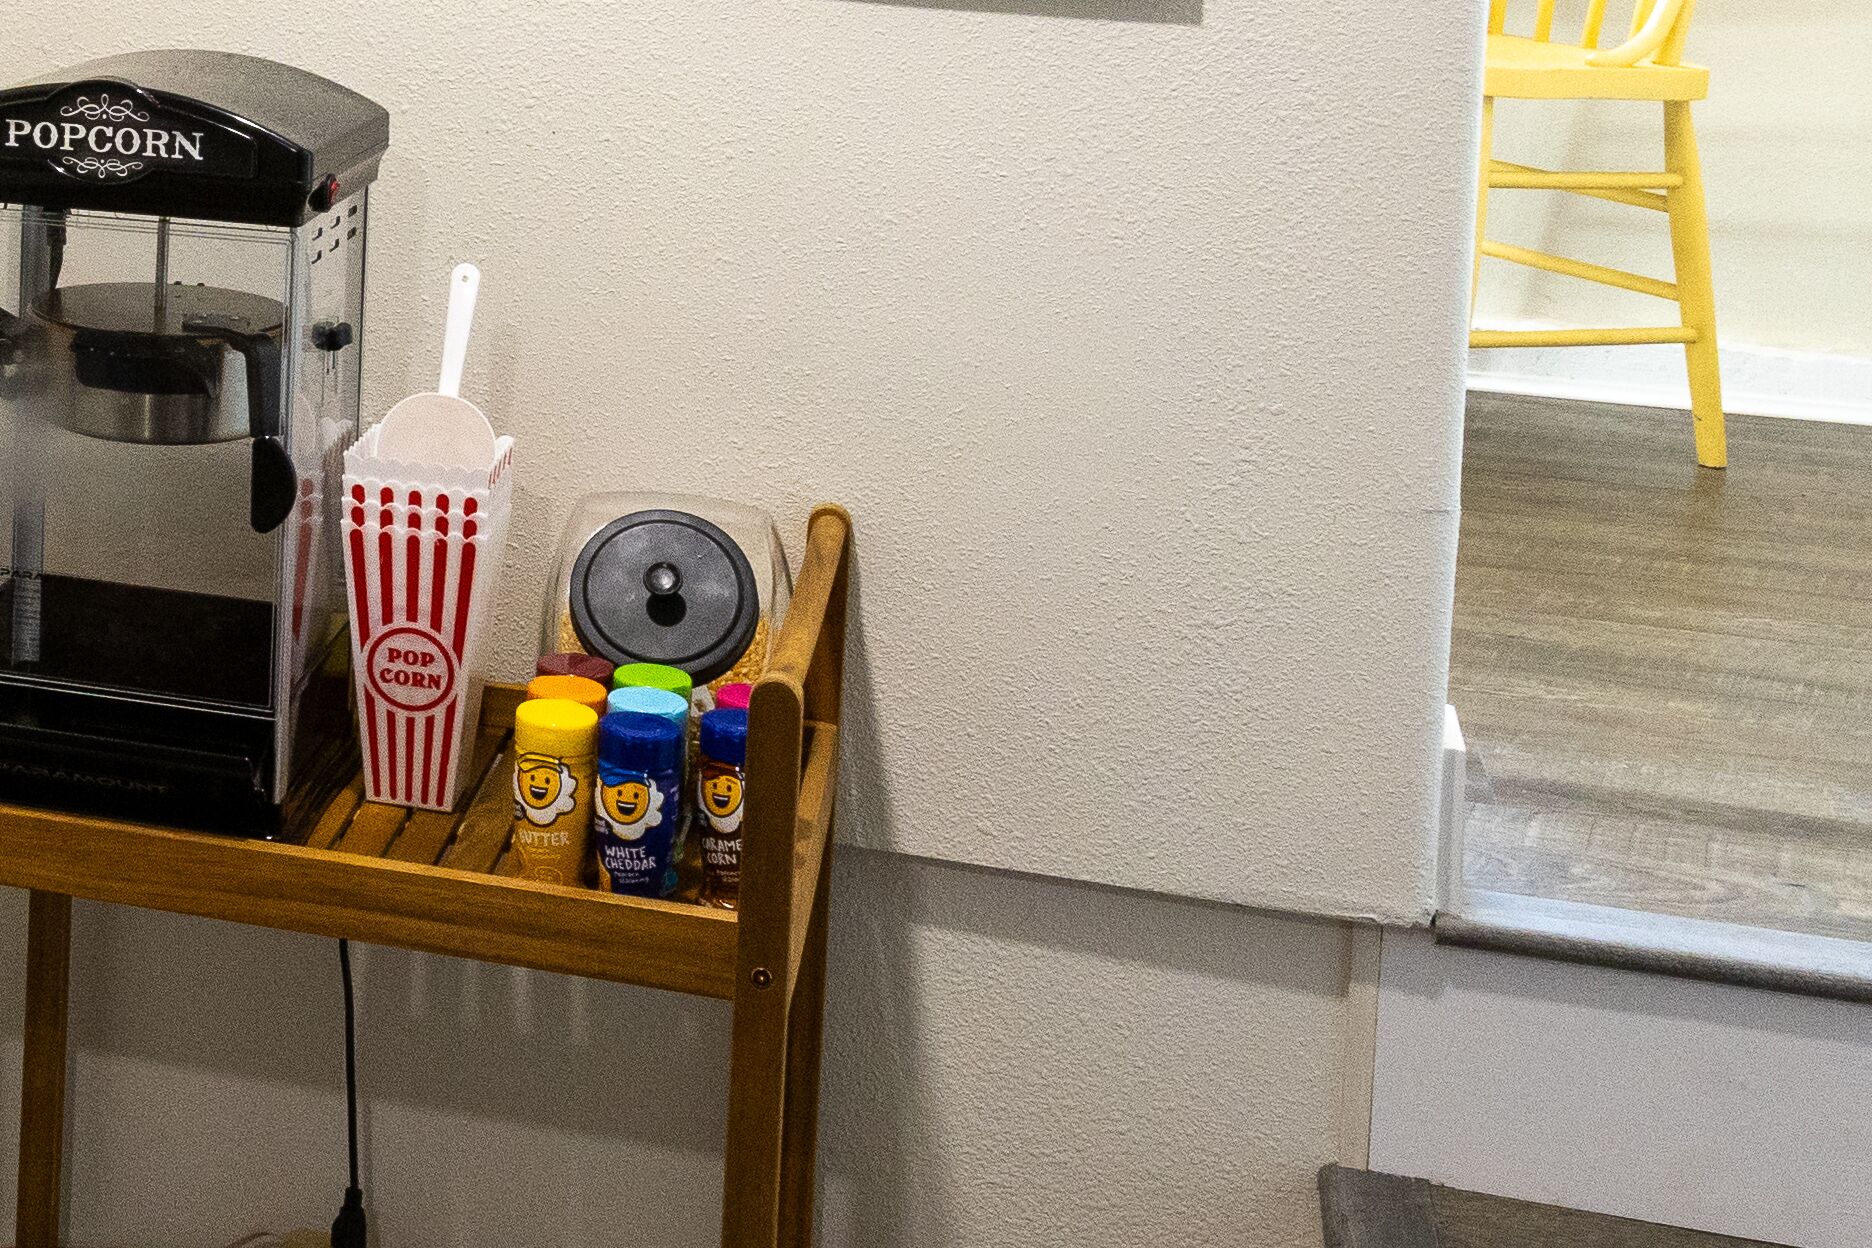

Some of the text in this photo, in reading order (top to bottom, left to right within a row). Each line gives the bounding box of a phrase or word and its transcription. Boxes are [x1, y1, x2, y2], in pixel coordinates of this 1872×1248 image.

[5, 118, 204, 161] POPCORN
[387, 647, 436, 668] POP
[379, 668, 442, 691] CORN
[518, 828, 570, 847] BUTTER
[702, 837, 743, 852] CARAME
[604, 845, 646, 859] WHITE
[707, 852, 738, 865] CORN
[604, 856, 657, 871] CHEDDAR
